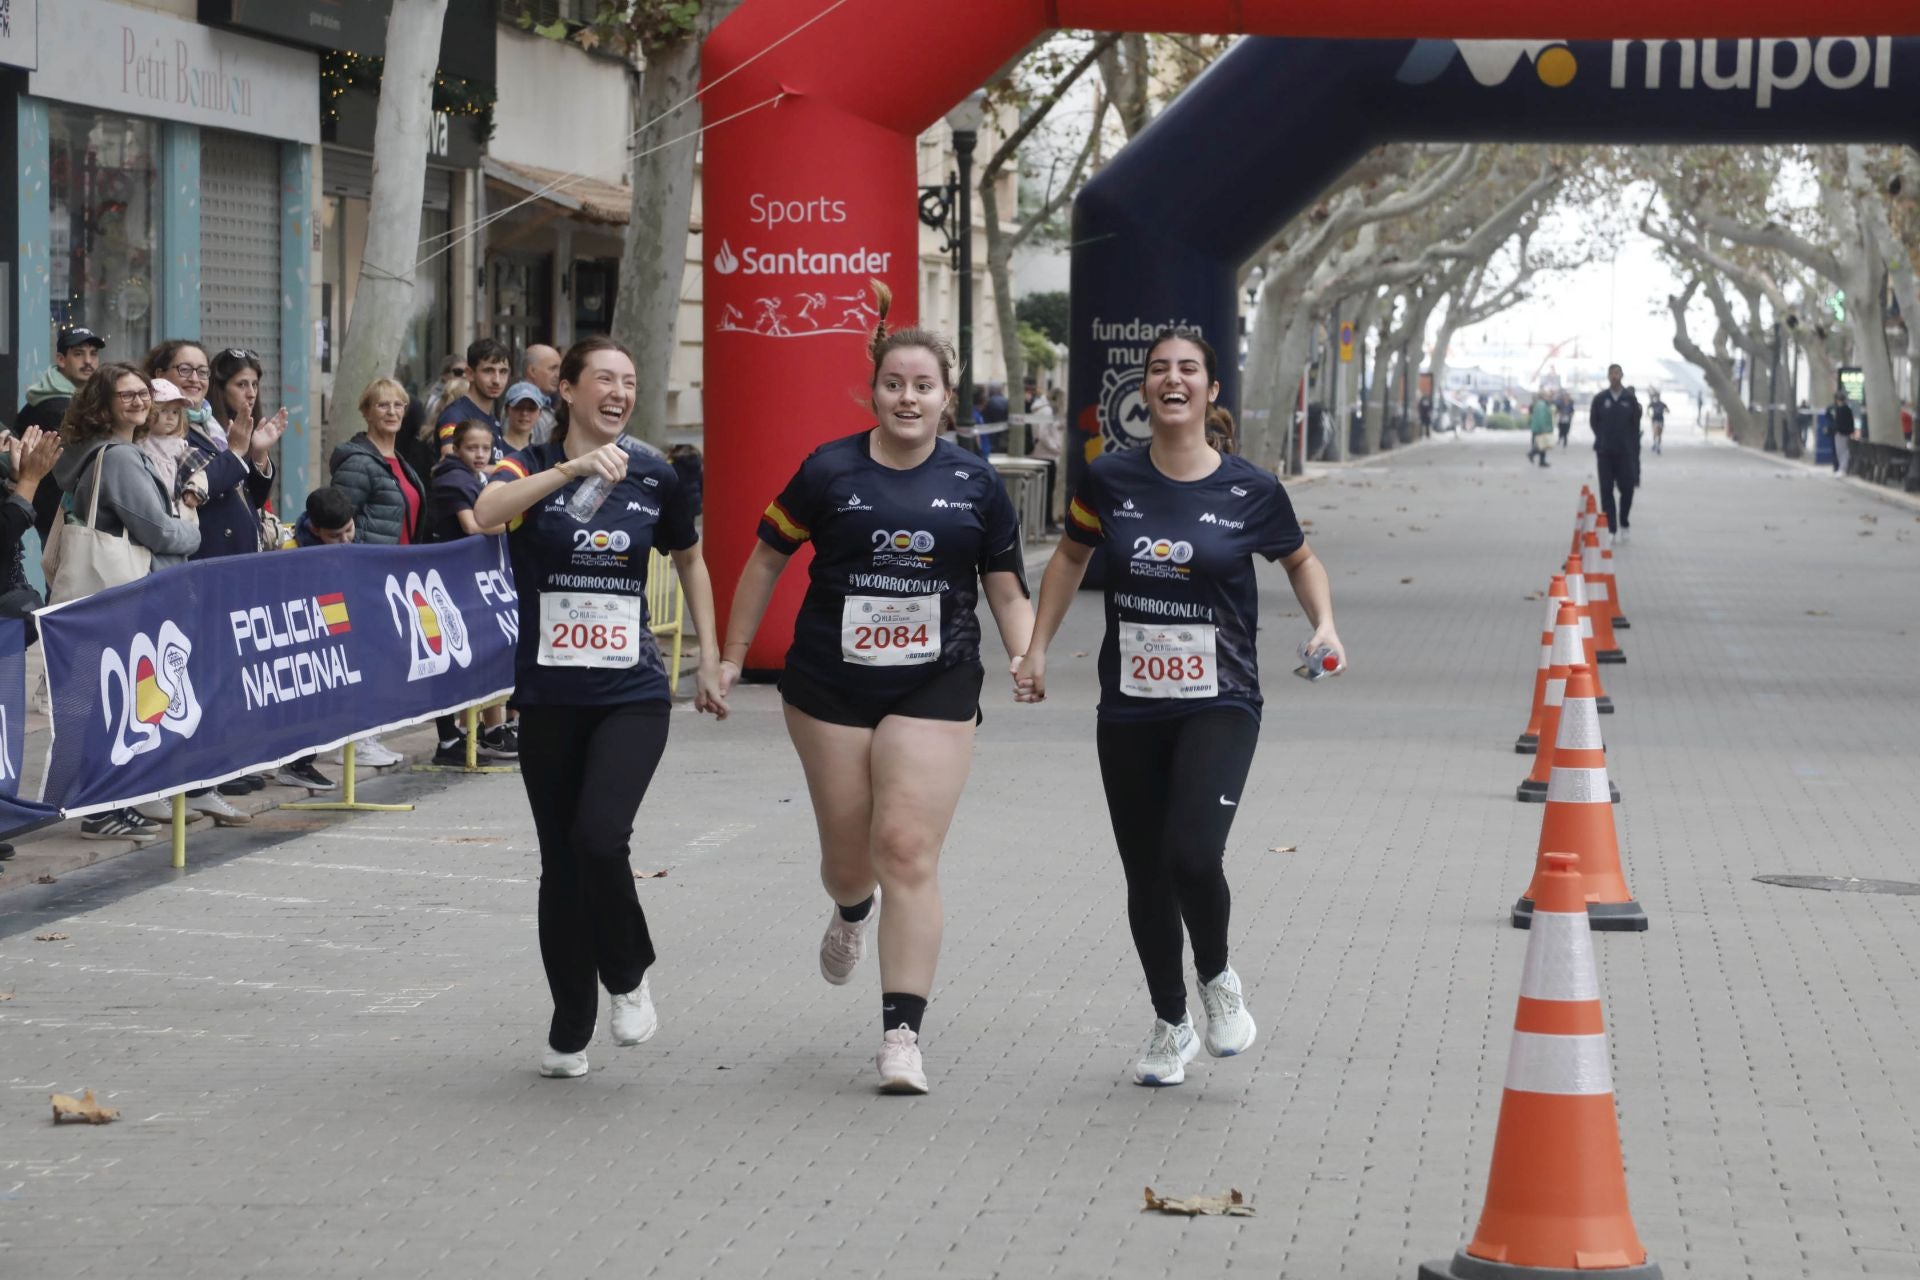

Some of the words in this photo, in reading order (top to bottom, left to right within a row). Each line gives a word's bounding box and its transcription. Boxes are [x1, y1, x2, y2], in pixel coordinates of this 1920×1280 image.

[121, 25, 168, 102] Petit
[176, 38, 252, 117] Bombón
[1610, 36, 1892, 108] mupol
[750, 193, 847, 231] Sports
[742, 247, 892, 274] Santander
[1112, 509, 1144, 519] Santander
[1218, 518, 1245, 530] mupol
[573, 529, 631, 552] 200
[871, 529, 935, 553] 200
[1131, 535, 1194, 564] 200
[571, 559, 628, 567] NACIONAL
[872, 560, 932, 569] NACIONAL
[1130, 568, 1191, 581] NACIONAL
[552, 623, 628, 650] 2085
[855, 623, 929, 650] 2084
[242, 644, 362, 711] NACIONAL
[1131, 655, 1204, 681] 2083
